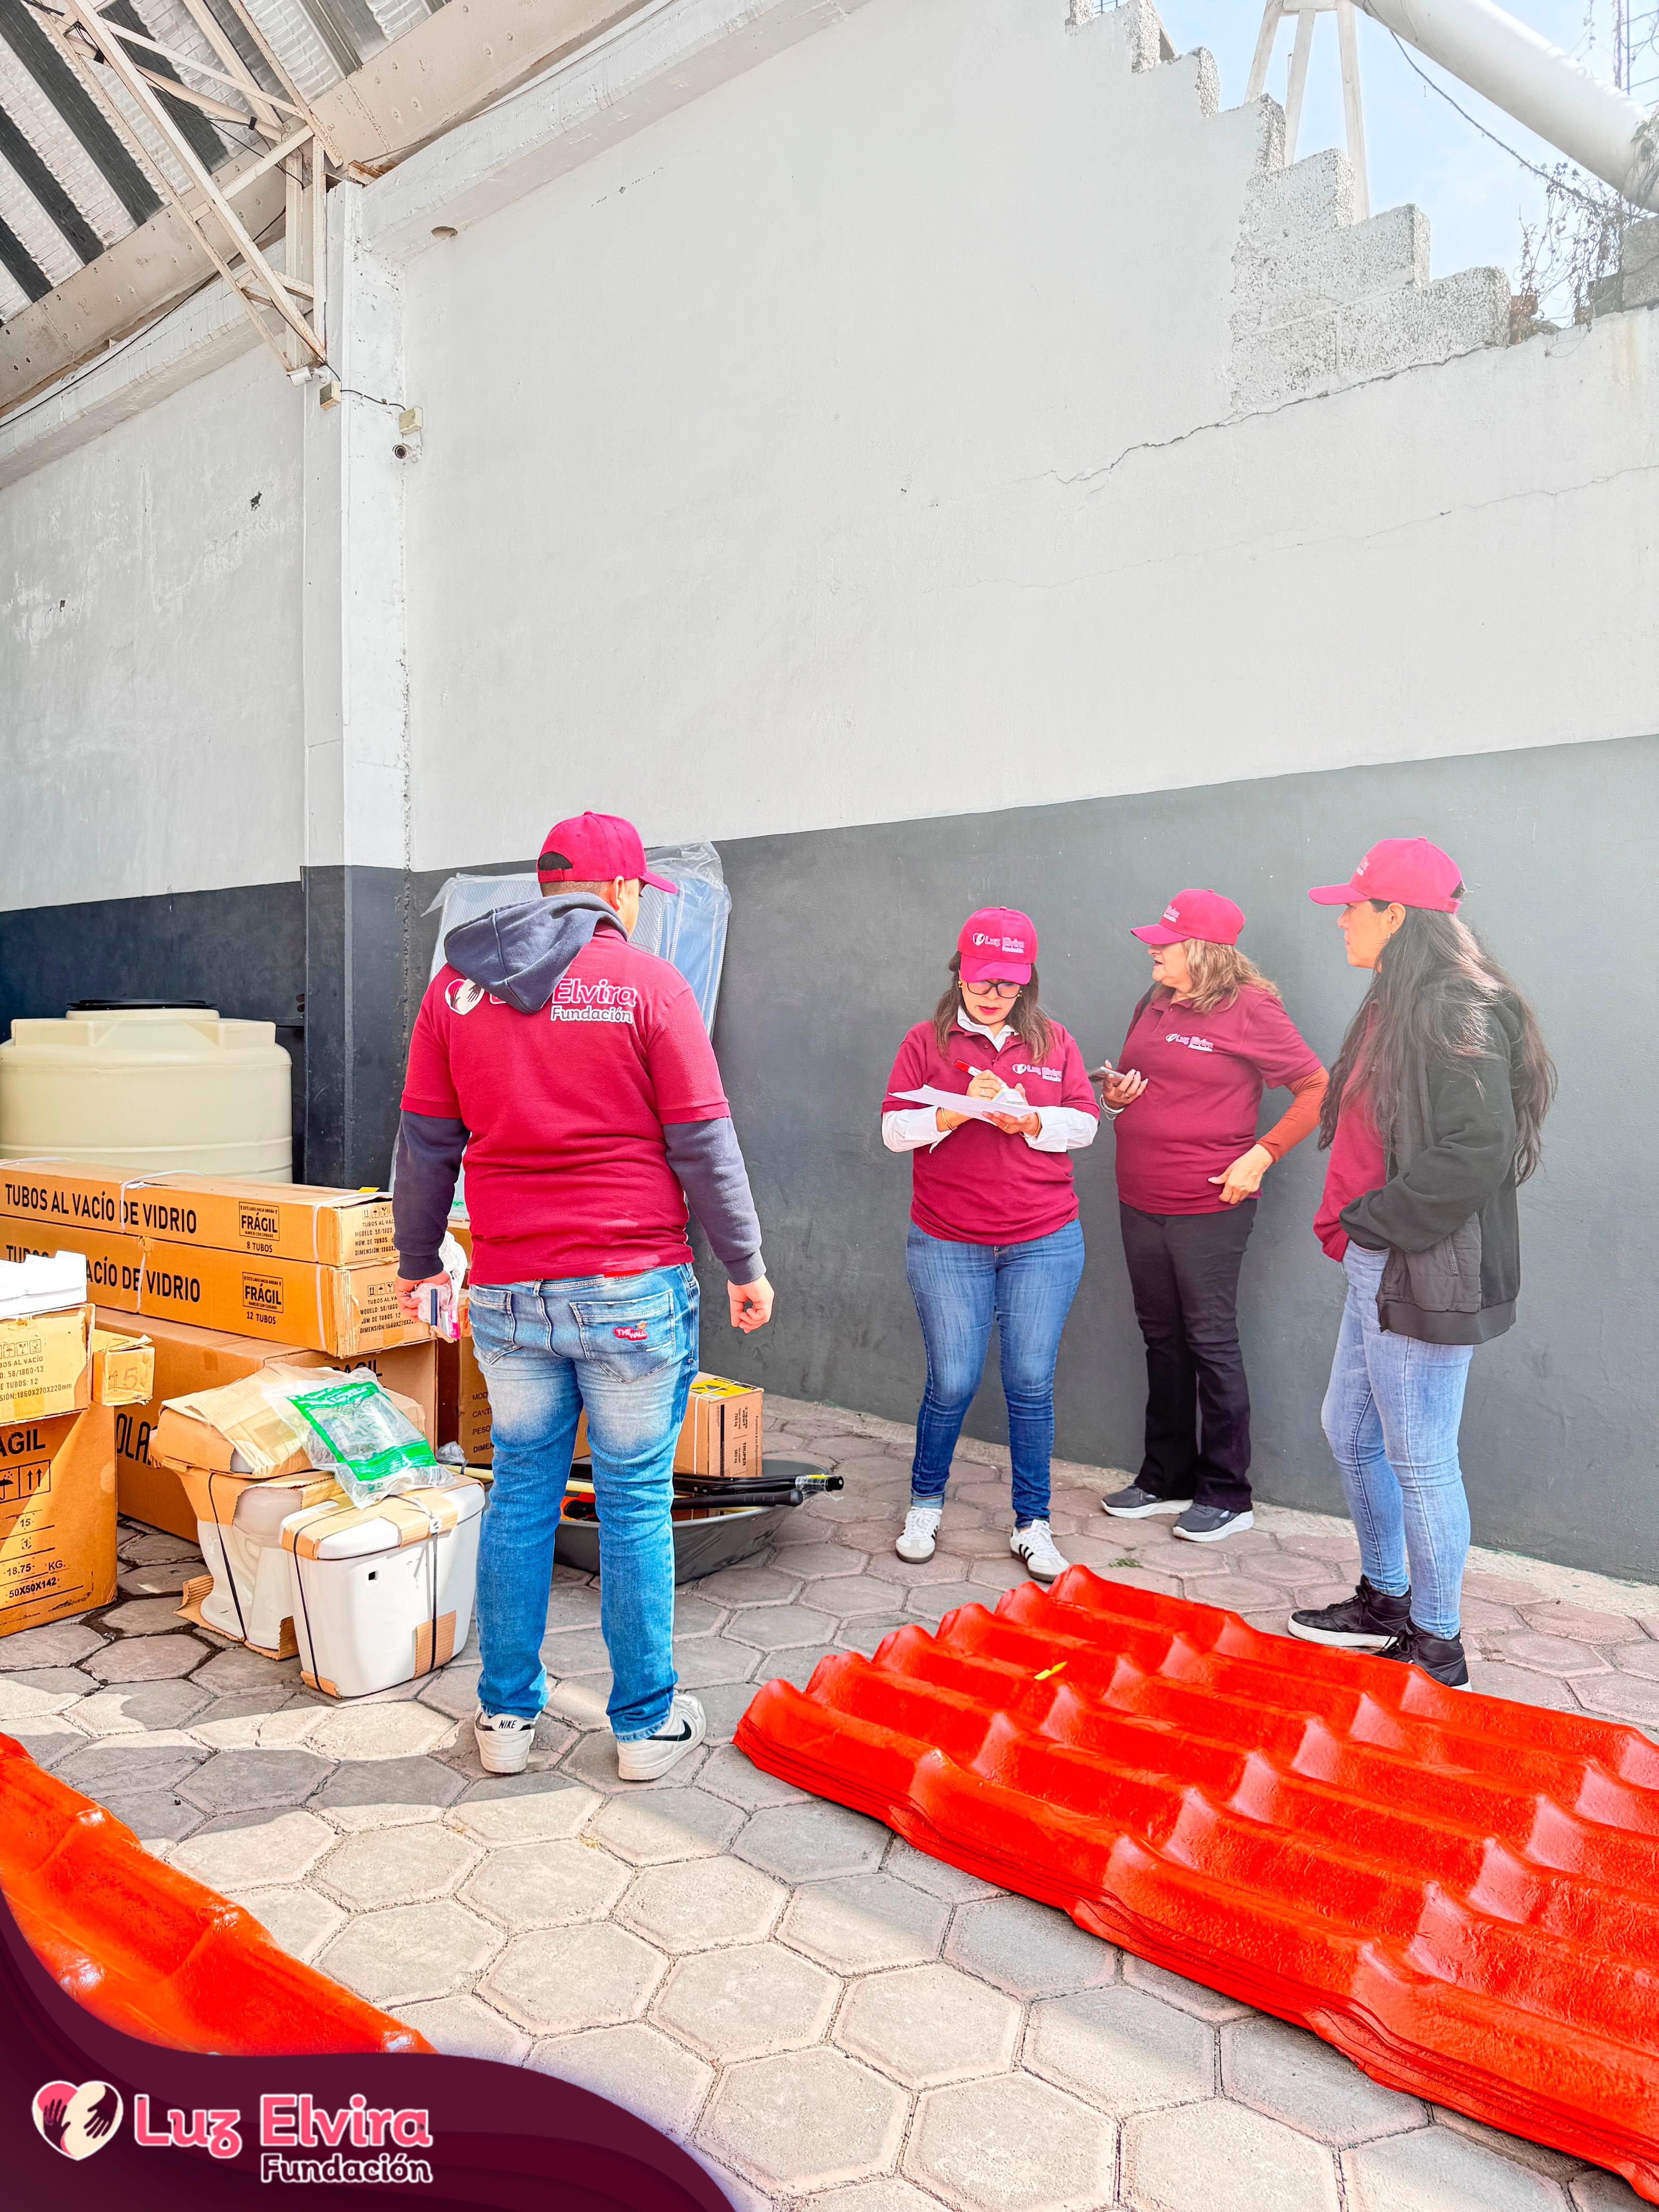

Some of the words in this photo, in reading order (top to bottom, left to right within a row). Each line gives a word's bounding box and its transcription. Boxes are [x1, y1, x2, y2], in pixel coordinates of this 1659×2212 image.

[552, 978, 638, 1007] Elvira
[550, 1005, 634, 1024] Fundación
[5, 1184, 48, 1211] TUBOS
[51, 1191, 69, 1214] AL
[72, 1191, 115, 1221] VACÍO
[120, 1200, 139, 1226] DE
[143, 1203, 197, 1234] VIDRIO
[241, 1212, 278, 1233] FRÁGIL
[252, 1242, 273, 1253] TUBOS
[86, 1255, 118, 1287] ACÍO
[146, 1270, 200, 1302] VIDRIO
[245, 1283, 282, 1305] FRÁGIL
[247, 1311, 254, 1320] 12
[256, 1313, 276, 1325] TUBOS
[23, 1355, 44, 1364] VACÍO
[8, 1366, 44, 1377] 58/1800-12
[473, 1425, 491, 1435] PESO
[116, 1413, 160, 1469] OLA
[9, 1577, 57, 1598] 50X50X142
[498, 1720, 517, 1729] NIKE
